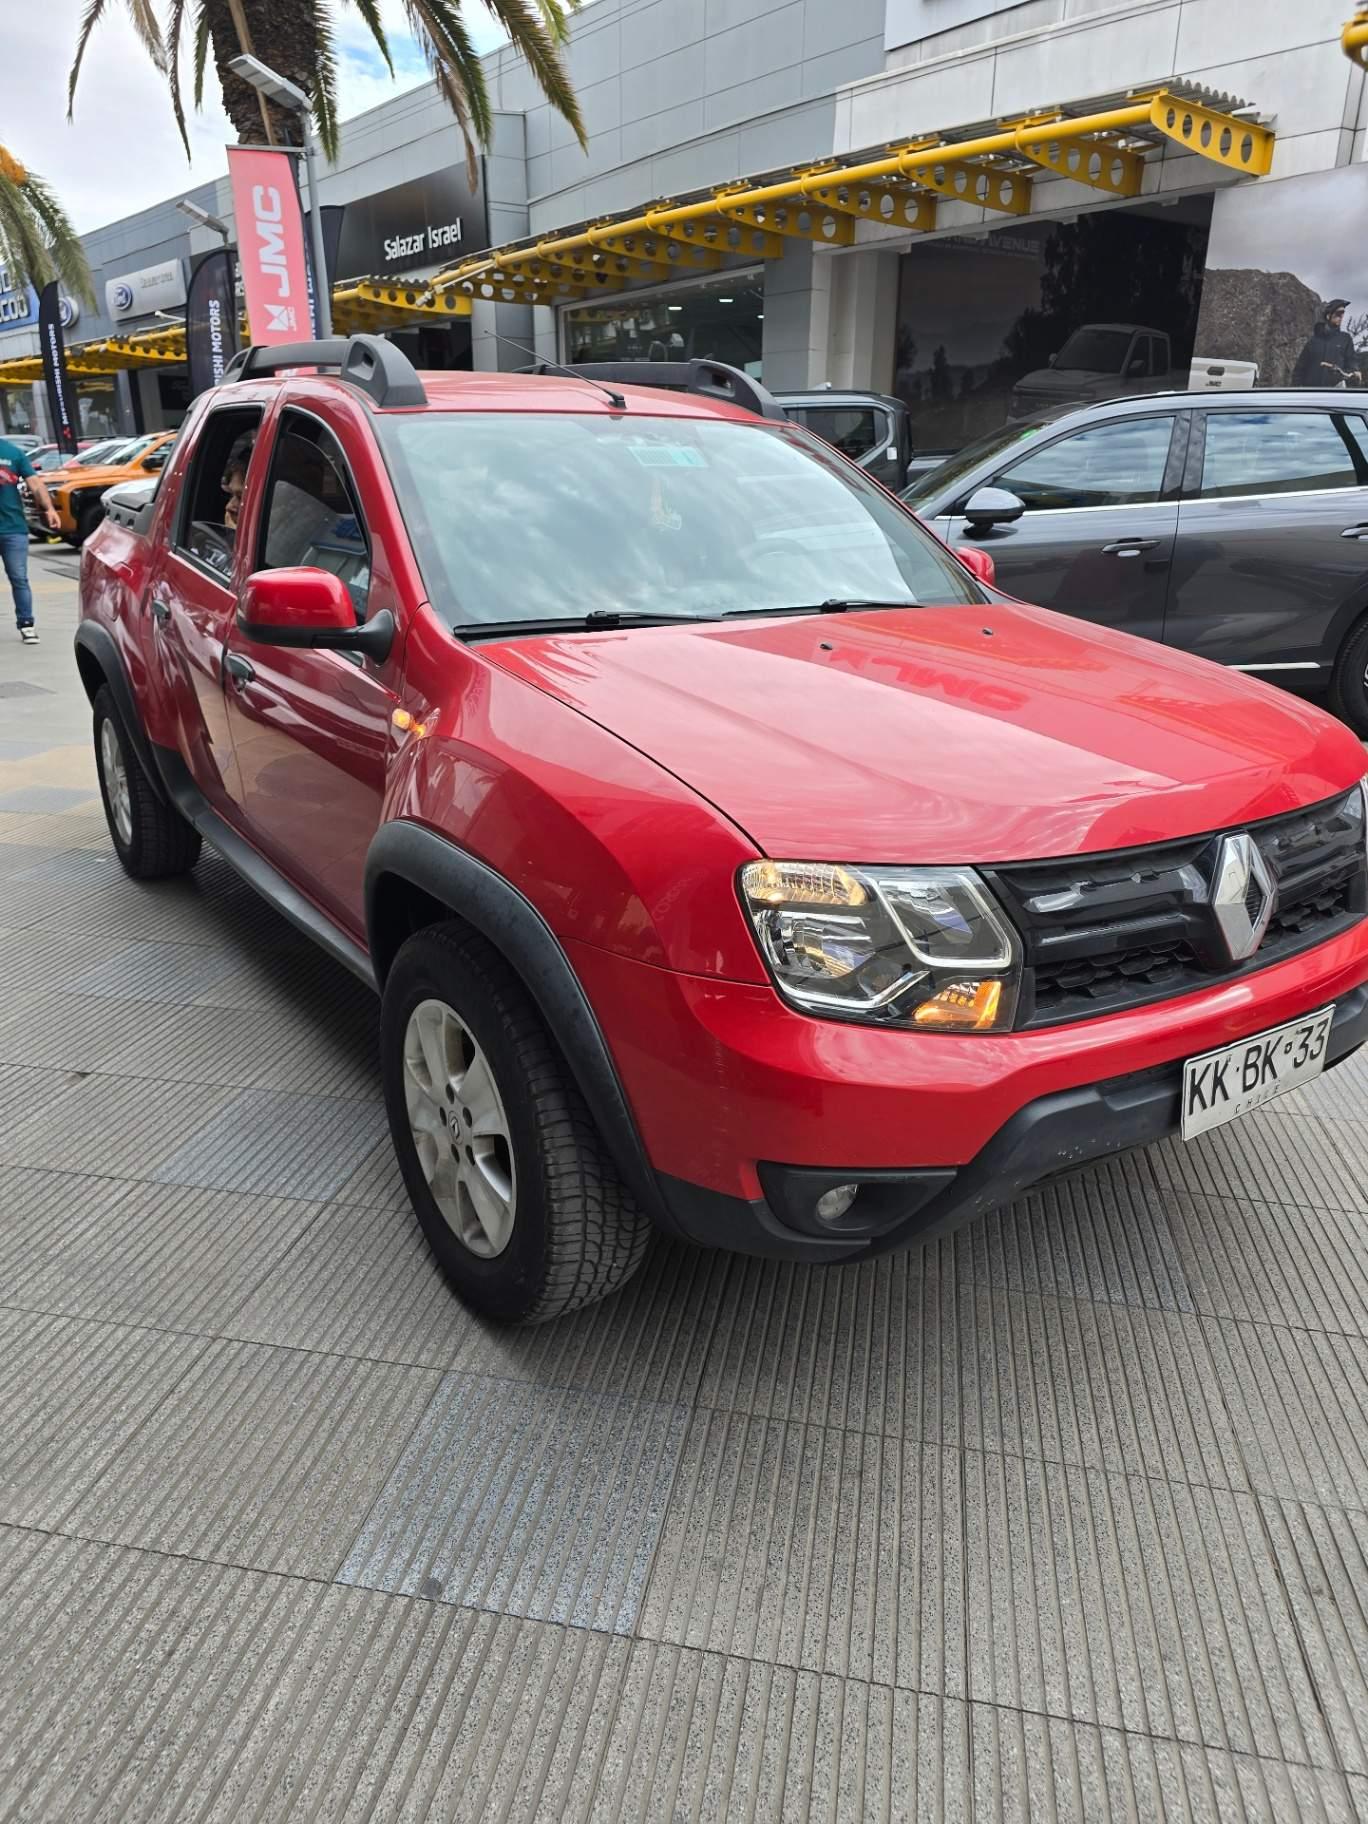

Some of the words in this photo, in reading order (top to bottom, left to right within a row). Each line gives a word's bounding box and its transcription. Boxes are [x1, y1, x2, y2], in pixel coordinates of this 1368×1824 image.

[253, 185, 290, 297] JMC
[384, 233, 425, 260] Salazar
[427, 217, 461, 248] Israel
[208, 299, 223, 353] MOTORS
